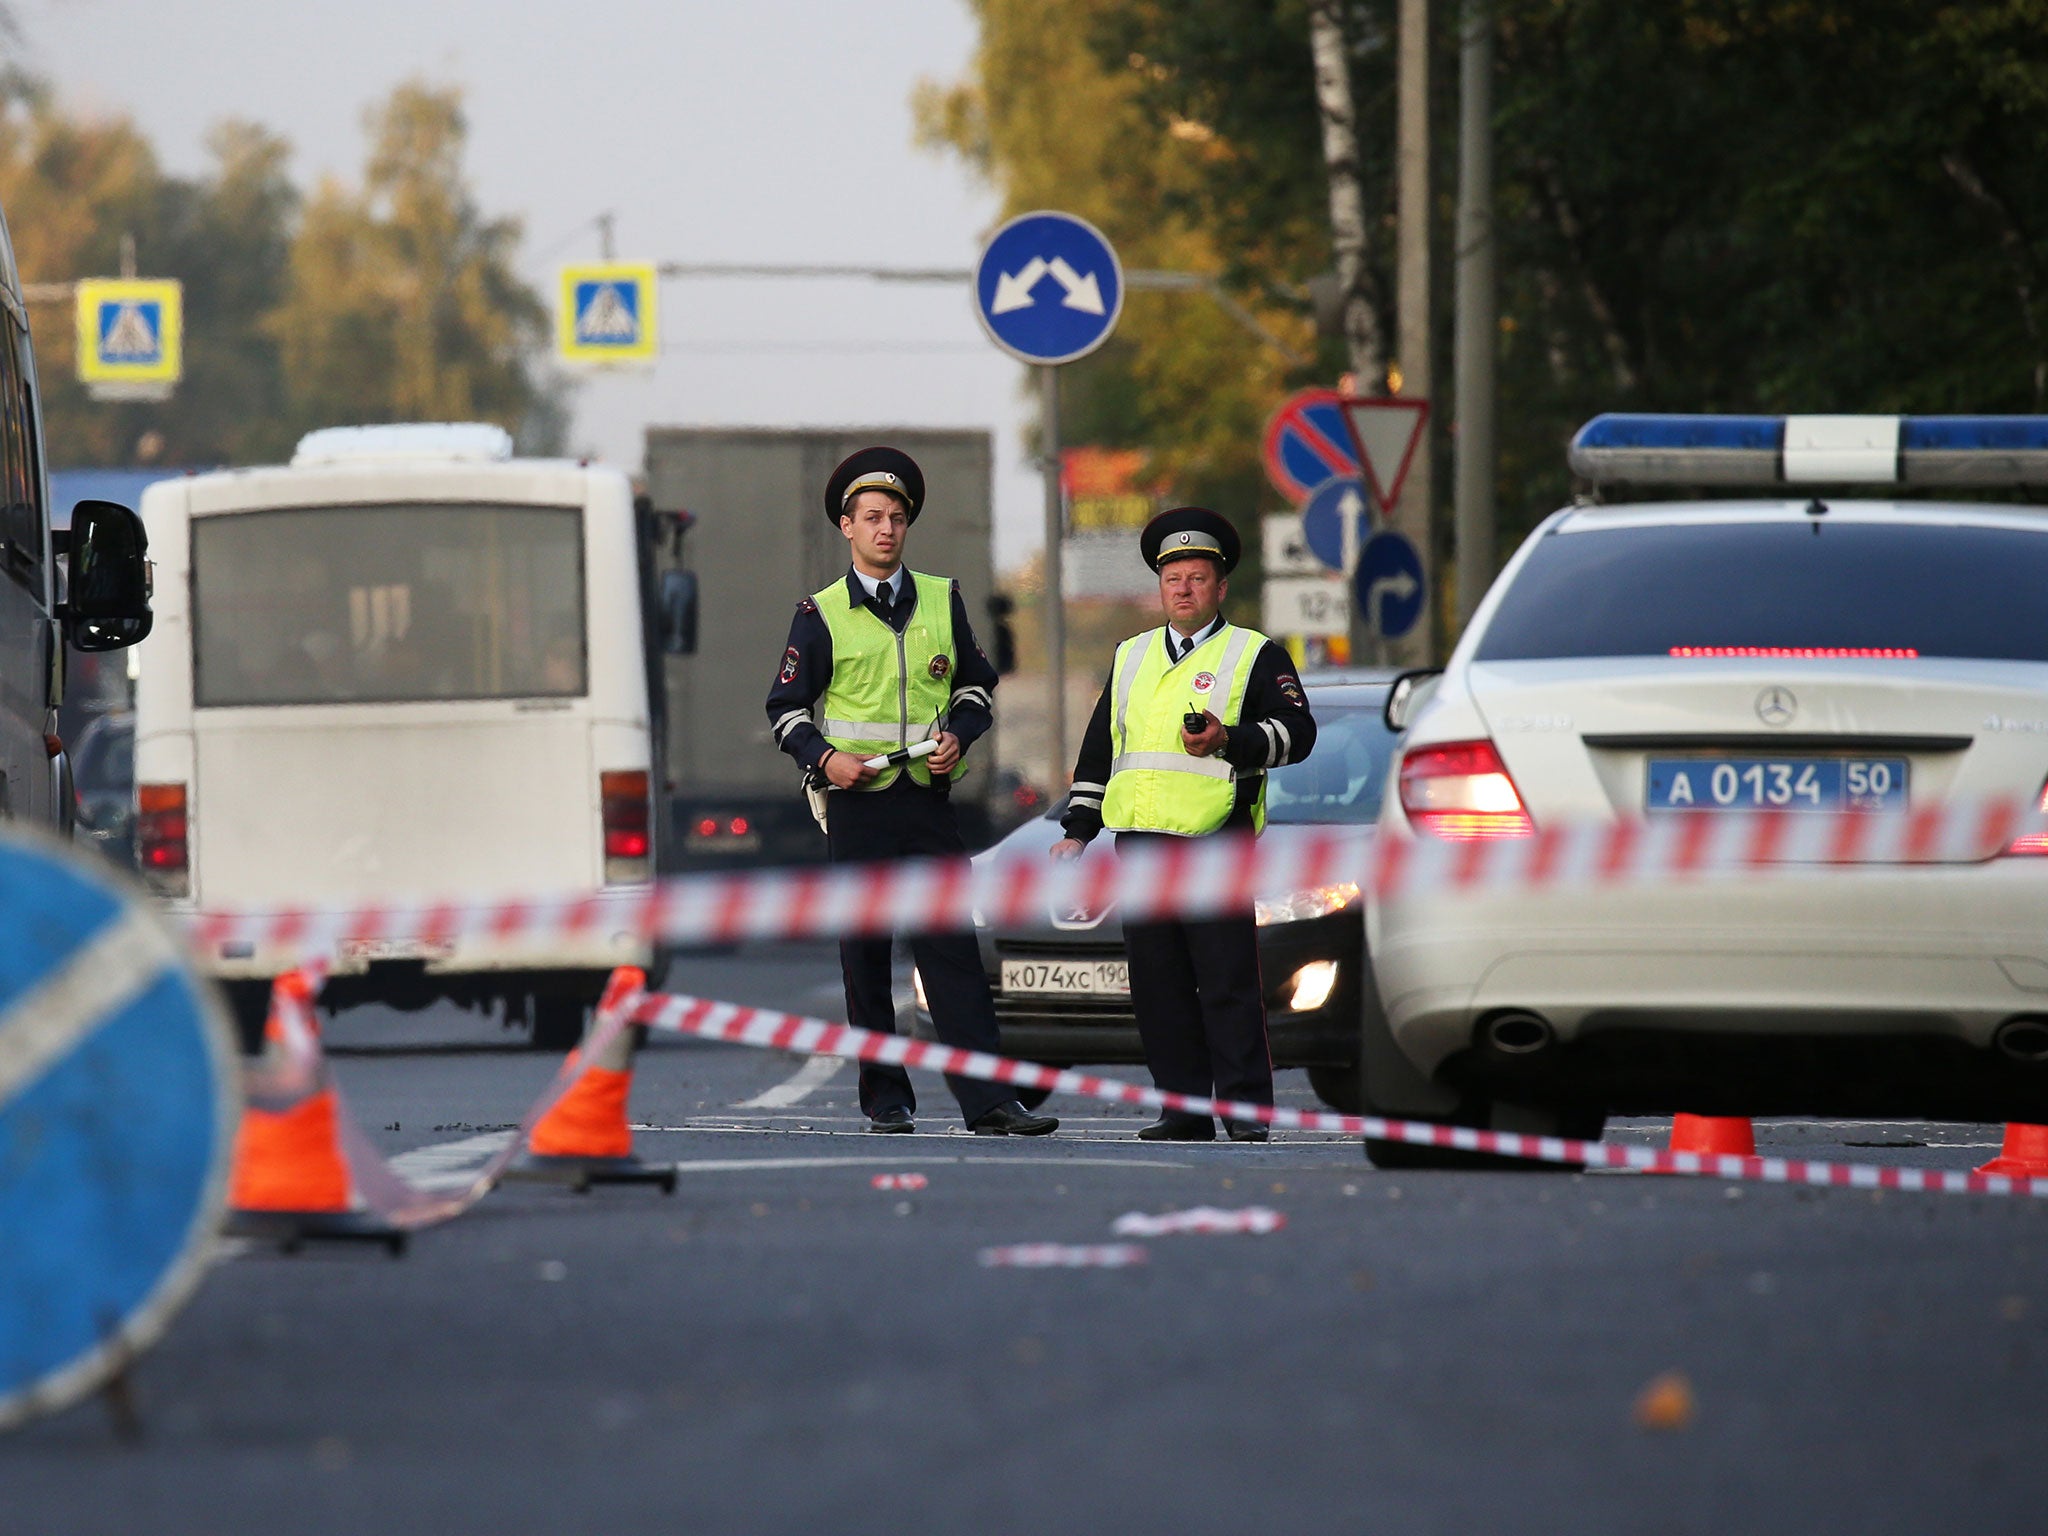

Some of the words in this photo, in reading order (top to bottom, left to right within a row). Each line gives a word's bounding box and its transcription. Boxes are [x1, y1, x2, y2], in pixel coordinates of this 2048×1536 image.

[1711, 763, 1821, 805] 0134
[1848, 762, 1892, 794] 50
[1096, 962, 1128, 983] 190
